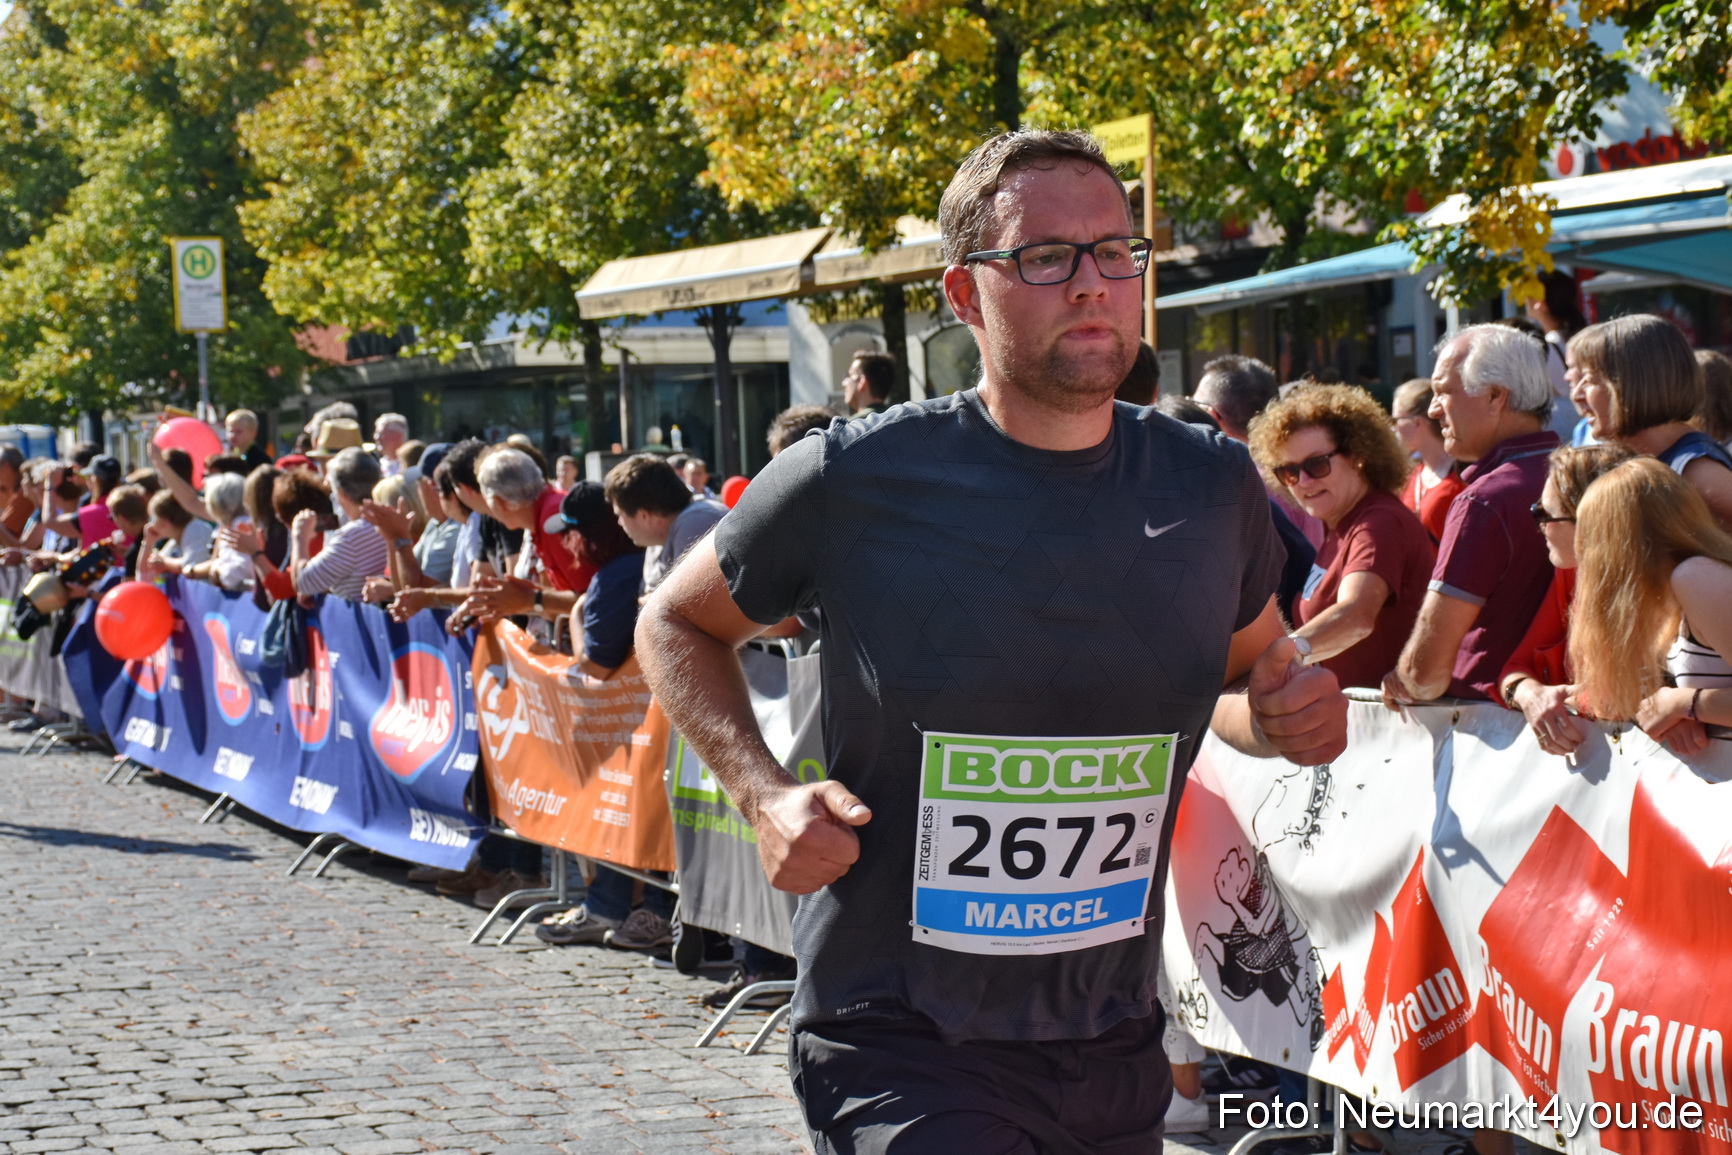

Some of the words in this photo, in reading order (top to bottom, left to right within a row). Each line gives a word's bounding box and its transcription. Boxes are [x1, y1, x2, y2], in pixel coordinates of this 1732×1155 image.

[942, 744, 1154, 795] BOCK
[507, 778, 567, 816] Agentur
[948, 812, 1136, 880] 2672
[964, 897, 1109, 929] MARCEL
[1586, 927, 1605, 951] Seit
[1603, 897, 1624, 927] 1929
[836, 1001, 870, 1015] DRI-FIT
[1386, 967, 1464, 1051] Braun
[1418, 1029, 1446, 1051] Sicher
[1444, 1021, 1457, 1035] ist
[1457, 1007, 1476, 1027] sicher
[1478, 937, 1552, 1075] Braun
[1586, 979, 1728, 1107] Braun
